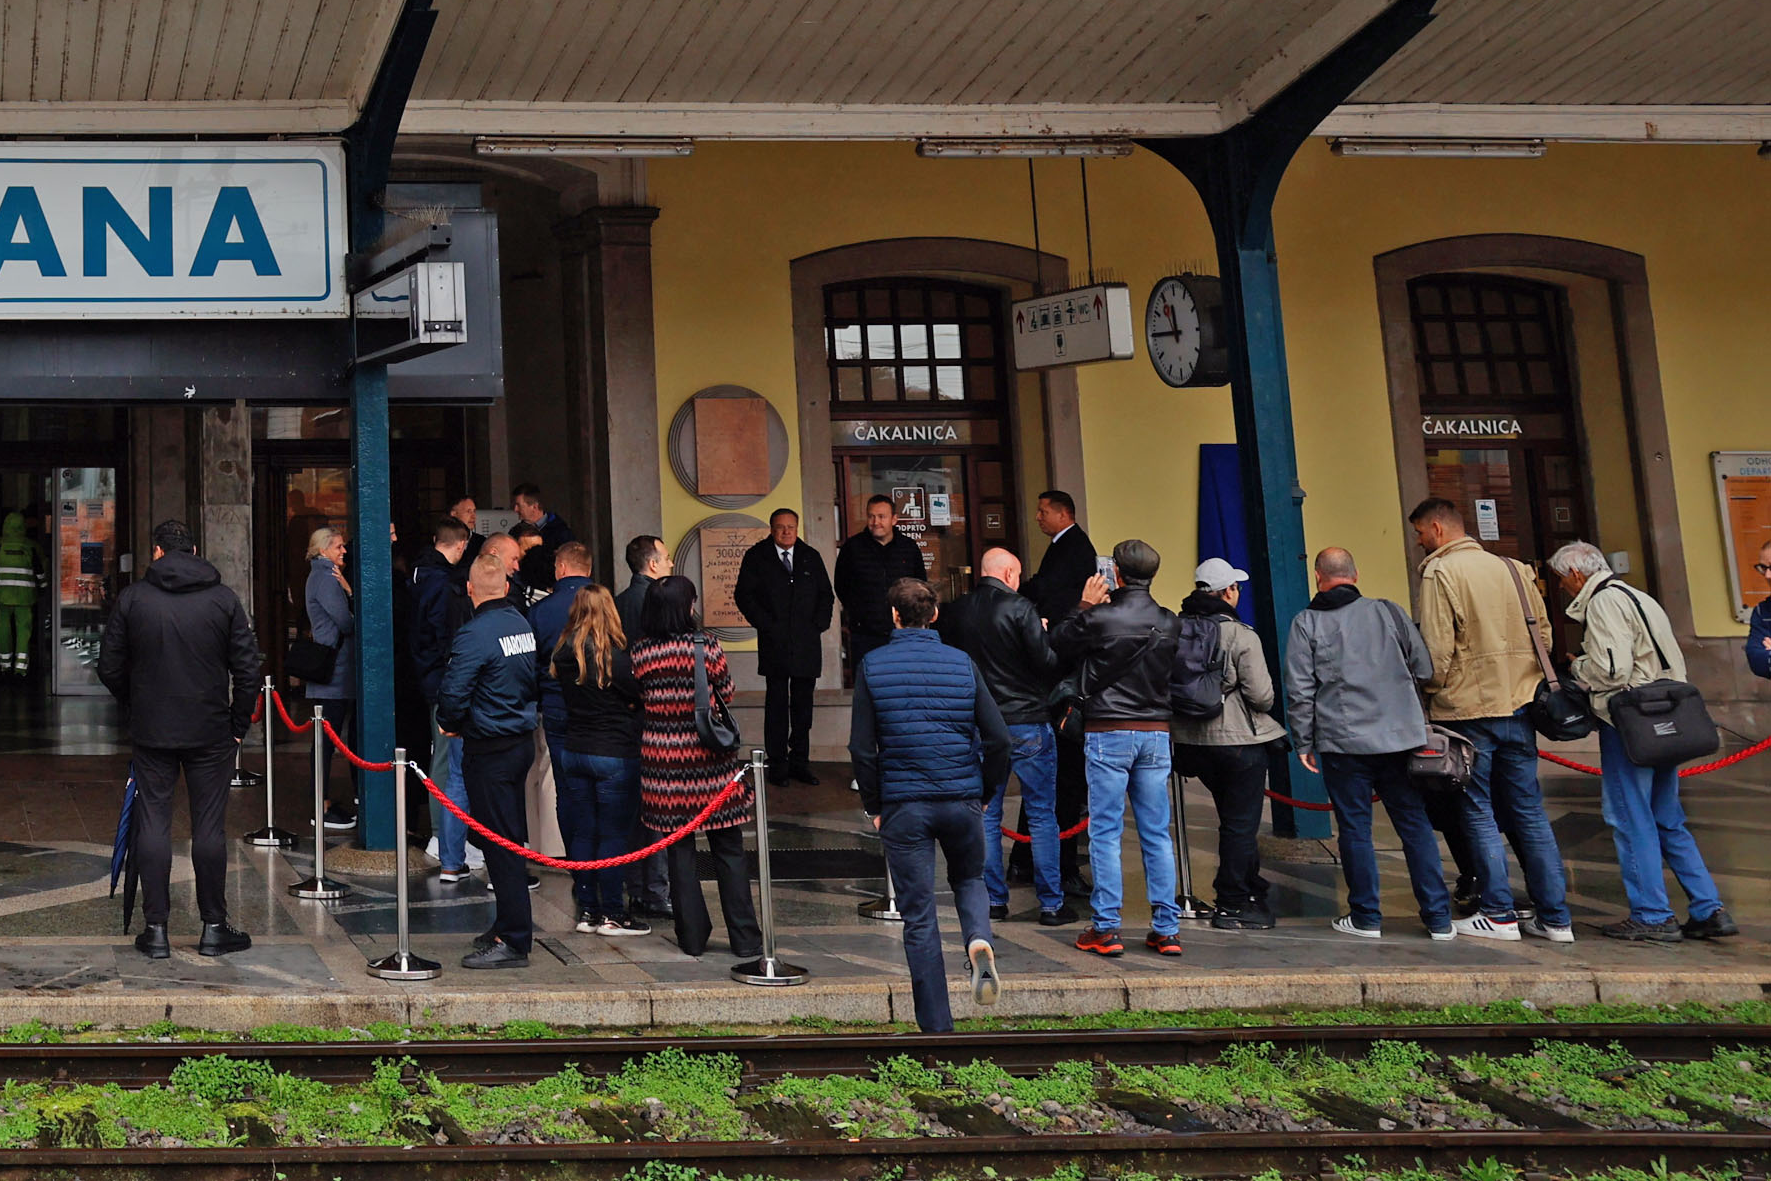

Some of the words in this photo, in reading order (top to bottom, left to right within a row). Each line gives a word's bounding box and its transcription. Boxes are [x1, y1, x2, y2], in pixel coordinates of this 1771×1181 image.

[1079, 302, 1090, 312] WC
[854, 421, 958, 441] ČAKALNICA
[1422, 416, 1523, 435] ČAKALNICA
